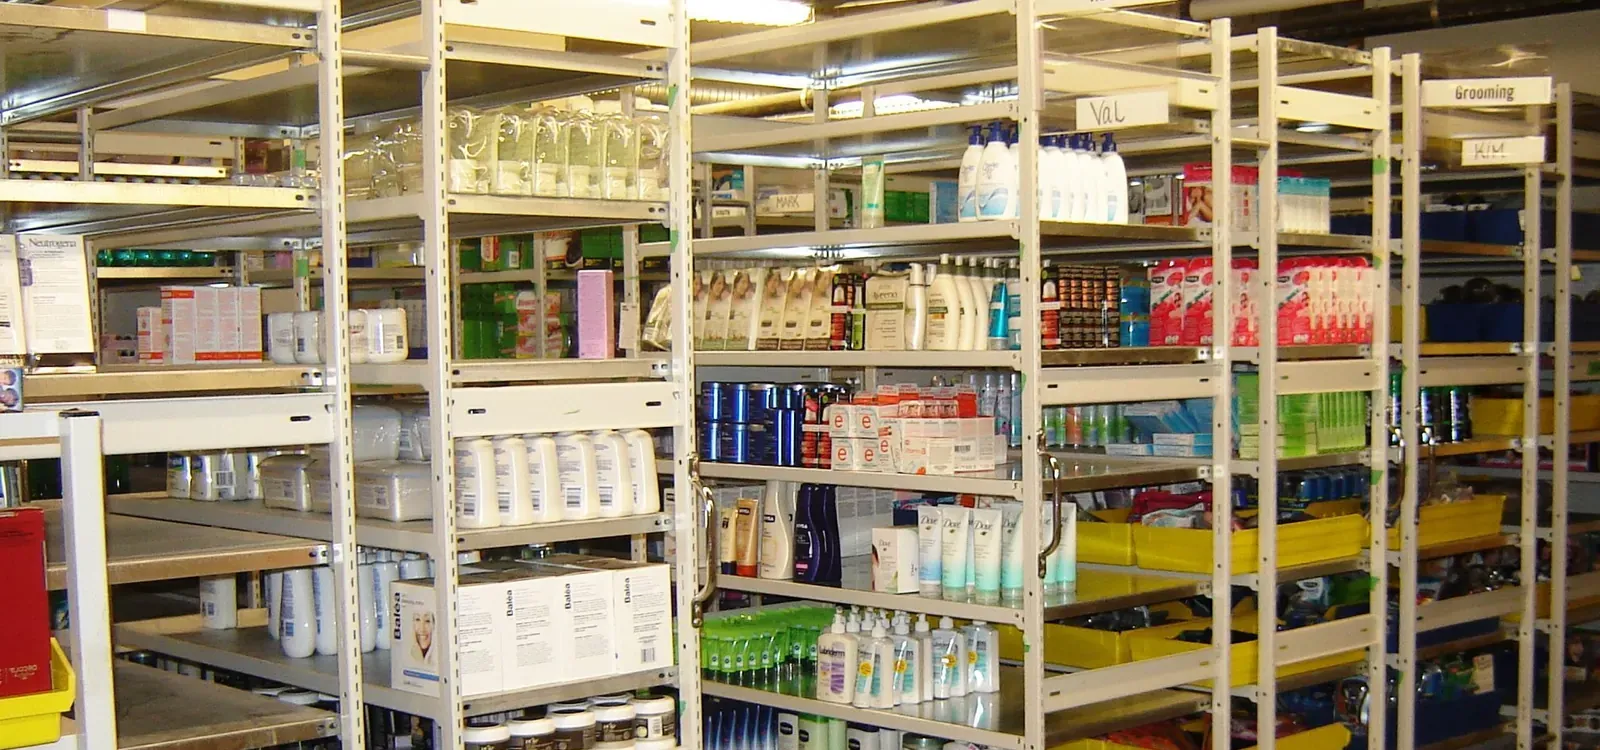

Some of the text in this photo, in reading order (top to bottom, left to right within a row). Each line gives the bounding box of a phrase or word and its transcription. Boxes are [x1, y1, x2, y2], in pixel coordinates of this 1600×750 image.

[1455, 84, 1515, 102] Grooming
[776, 195, 801, 209] MARK
[28, 238, 77, 249] Neutrogena
[921, 515, 938, 525] Dove
[943, 519, 961, 528] Dove
[974, 520, 992, 530] Dove
